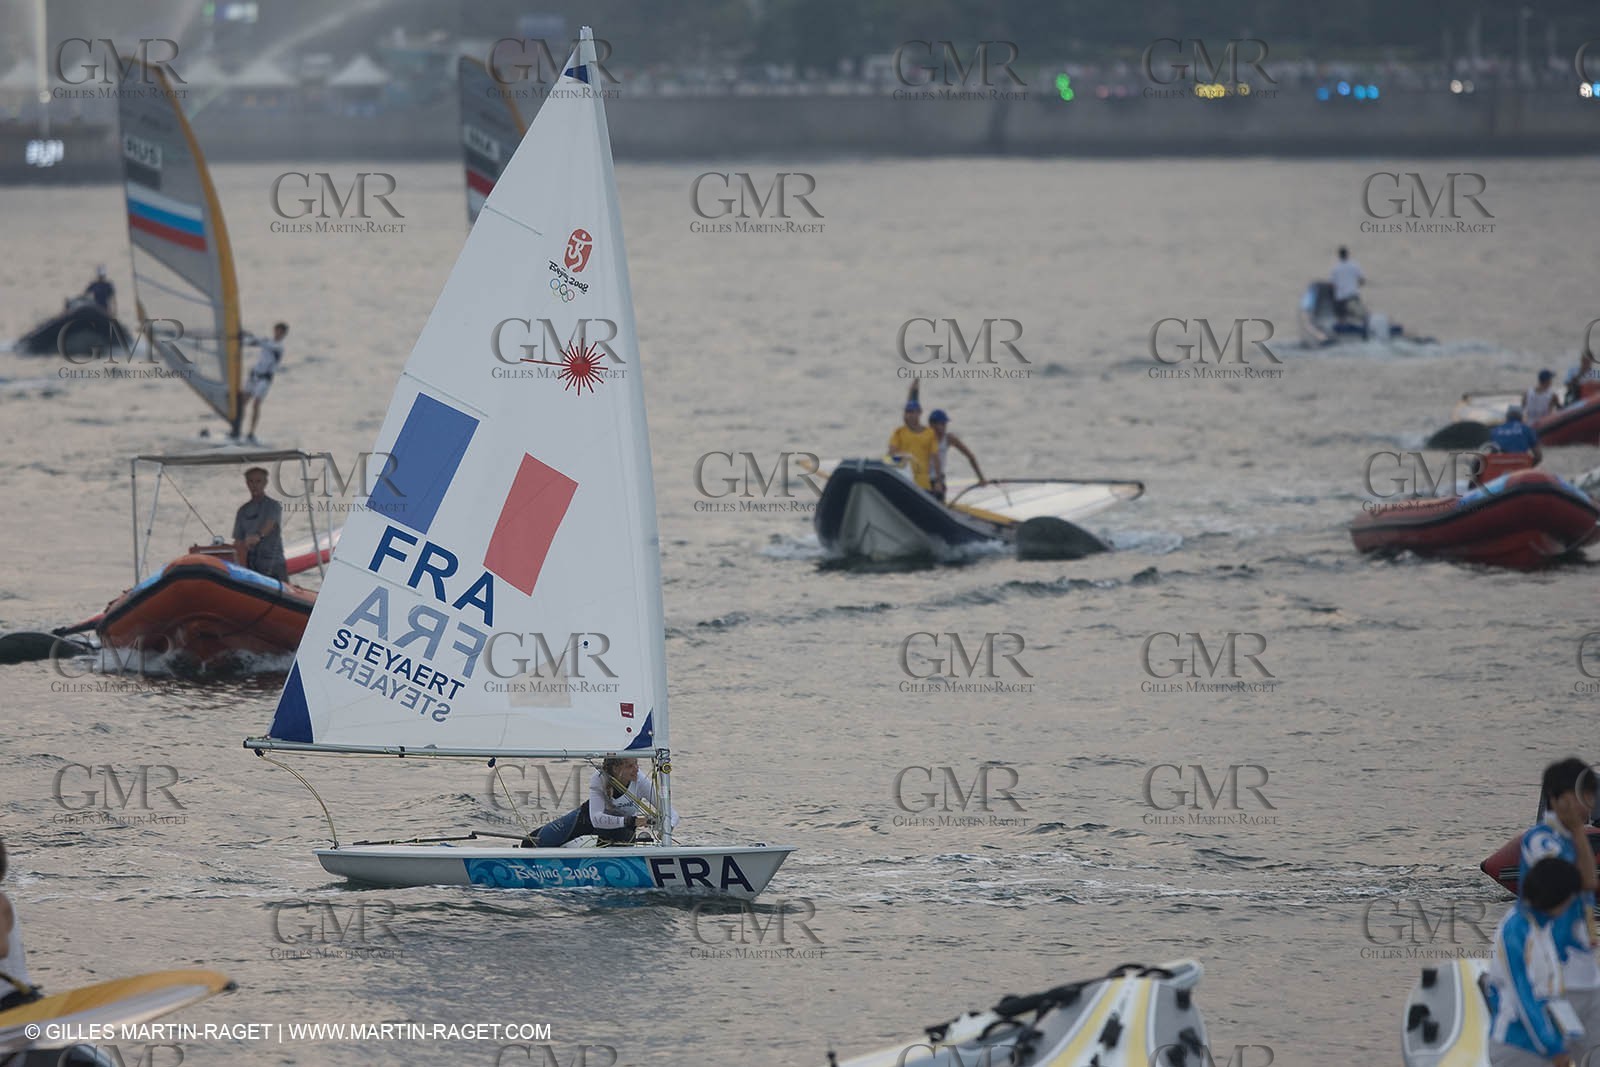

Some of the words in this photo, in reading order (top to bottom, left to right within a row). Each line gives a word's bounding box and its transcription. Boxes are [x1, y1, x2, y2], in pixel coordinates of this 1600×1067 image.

[368, 525, 494, 627] FRA
[333, 628, 465, 700] STEYAERT
[508, 864, 563, 884] Beijing
[562, 865, 601, 881] 2008
[649, 855, 755, 893] FRA
